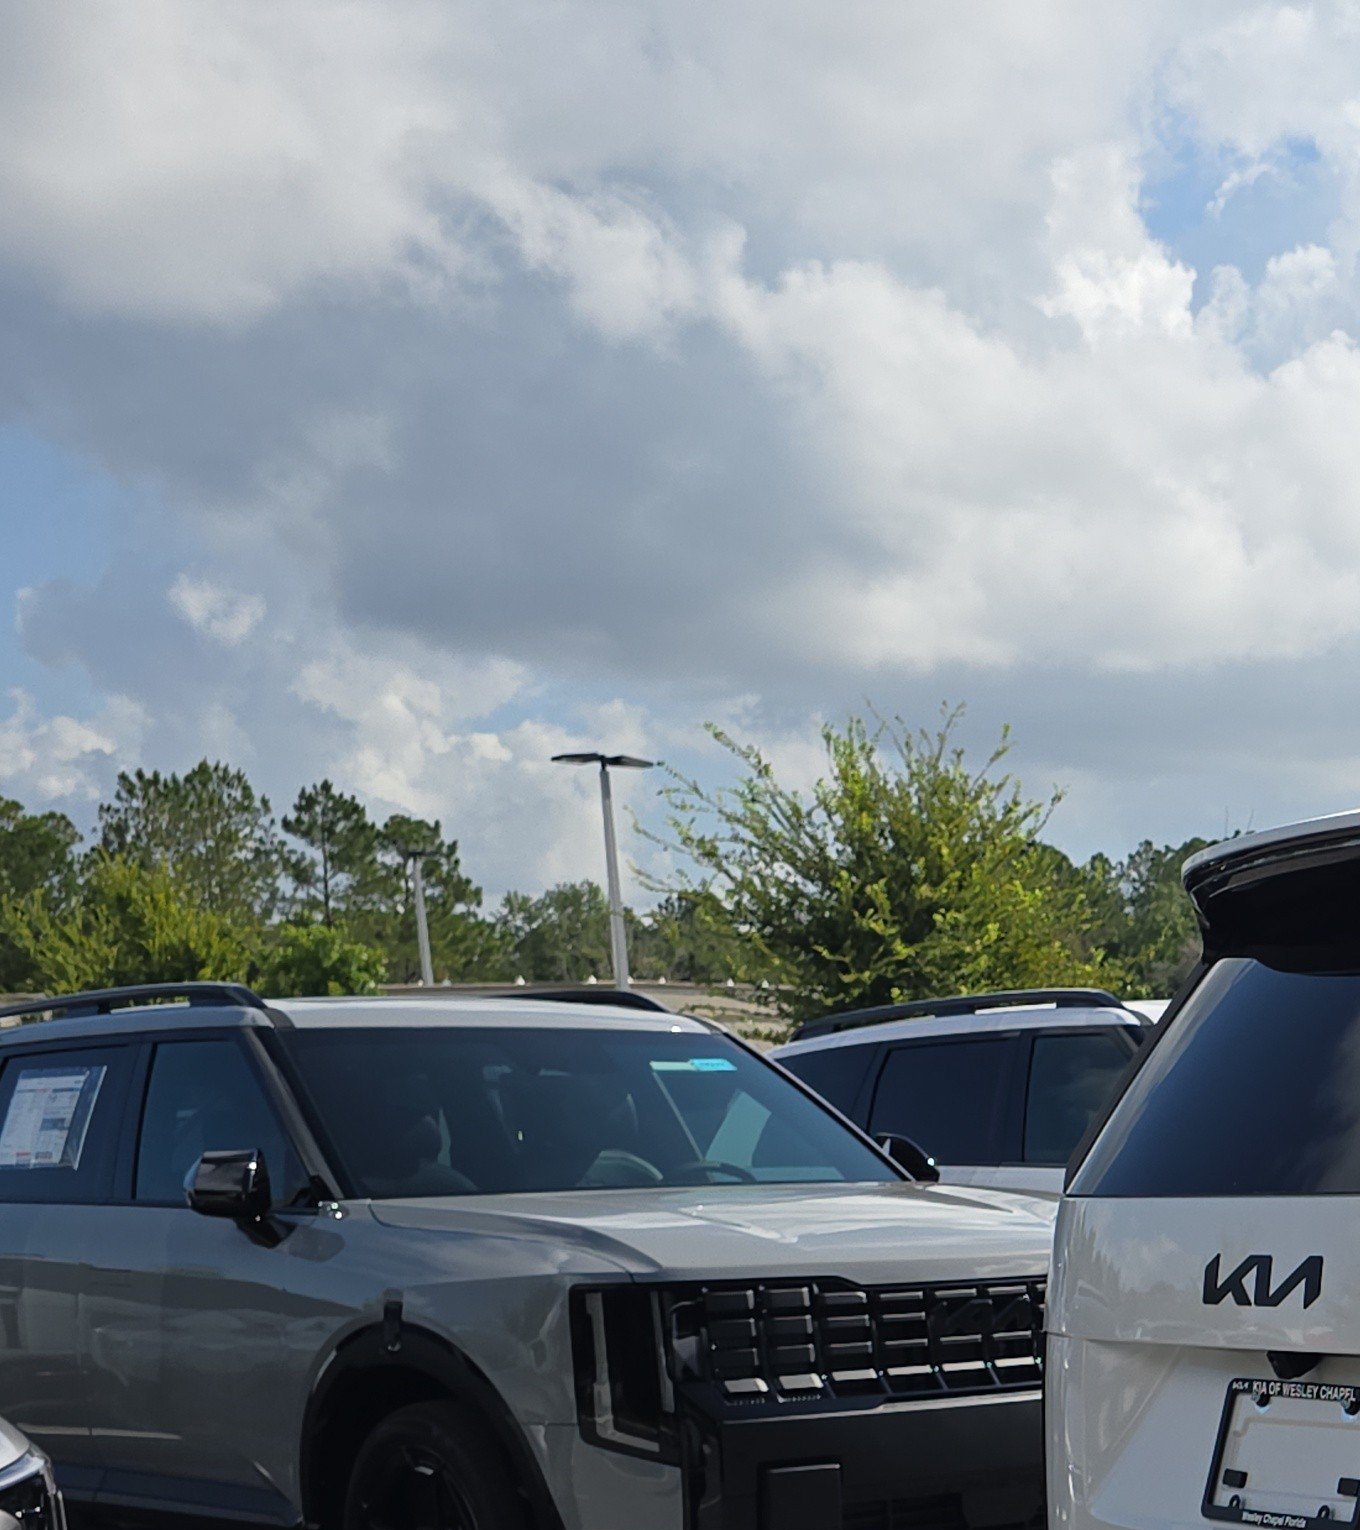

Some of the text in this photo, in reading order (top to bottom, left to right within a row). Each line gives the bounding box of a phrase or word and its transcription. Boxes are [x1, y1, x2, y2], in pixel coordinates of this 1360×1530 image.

[1202, 1252, 1324, 1310] KIA
[1252, 1380, 1268, 1396] KIA
[1268, 1381, 1282, 1396] OF
[1282, 1382, 1319, 1399] WESLEY
